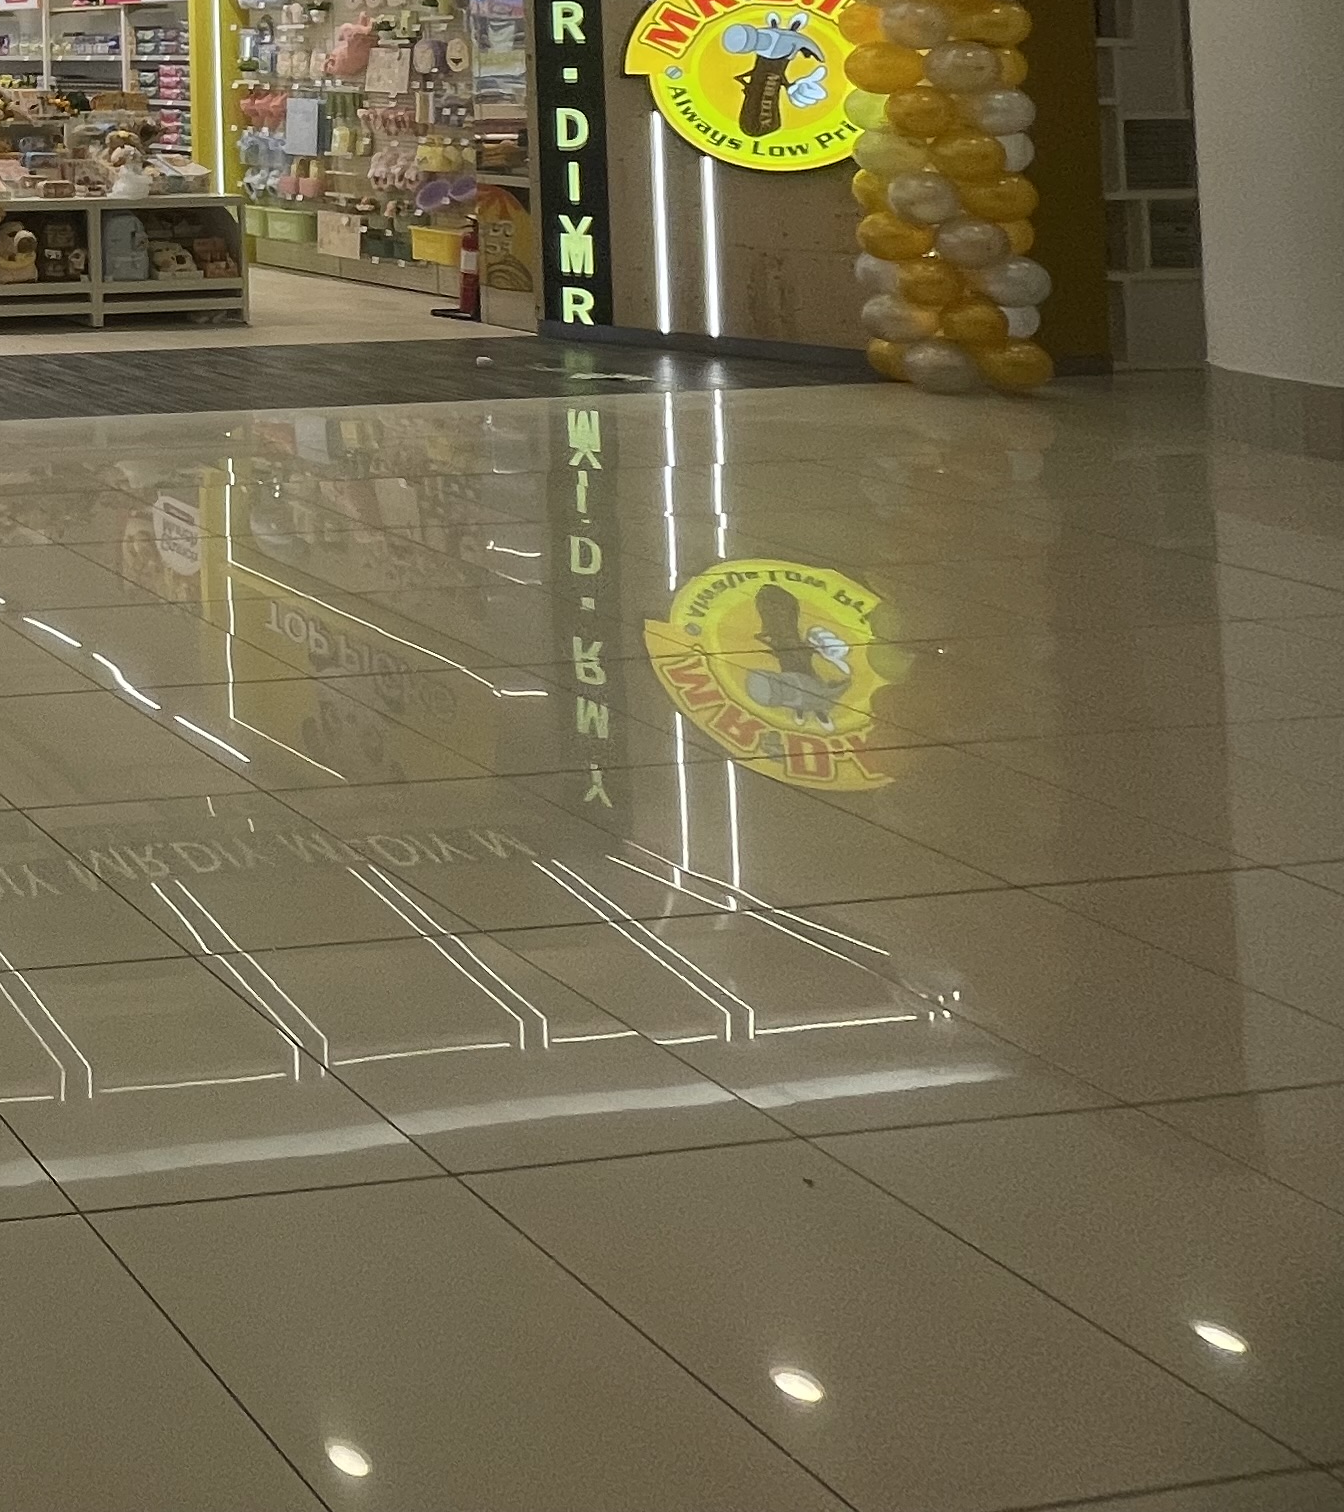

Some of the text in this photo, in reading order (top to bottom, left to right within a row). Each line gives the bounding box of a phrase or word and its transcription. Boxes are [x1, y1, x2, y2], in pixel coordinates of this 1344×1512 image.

[666, 84, 859, 158] Always Low Pri
